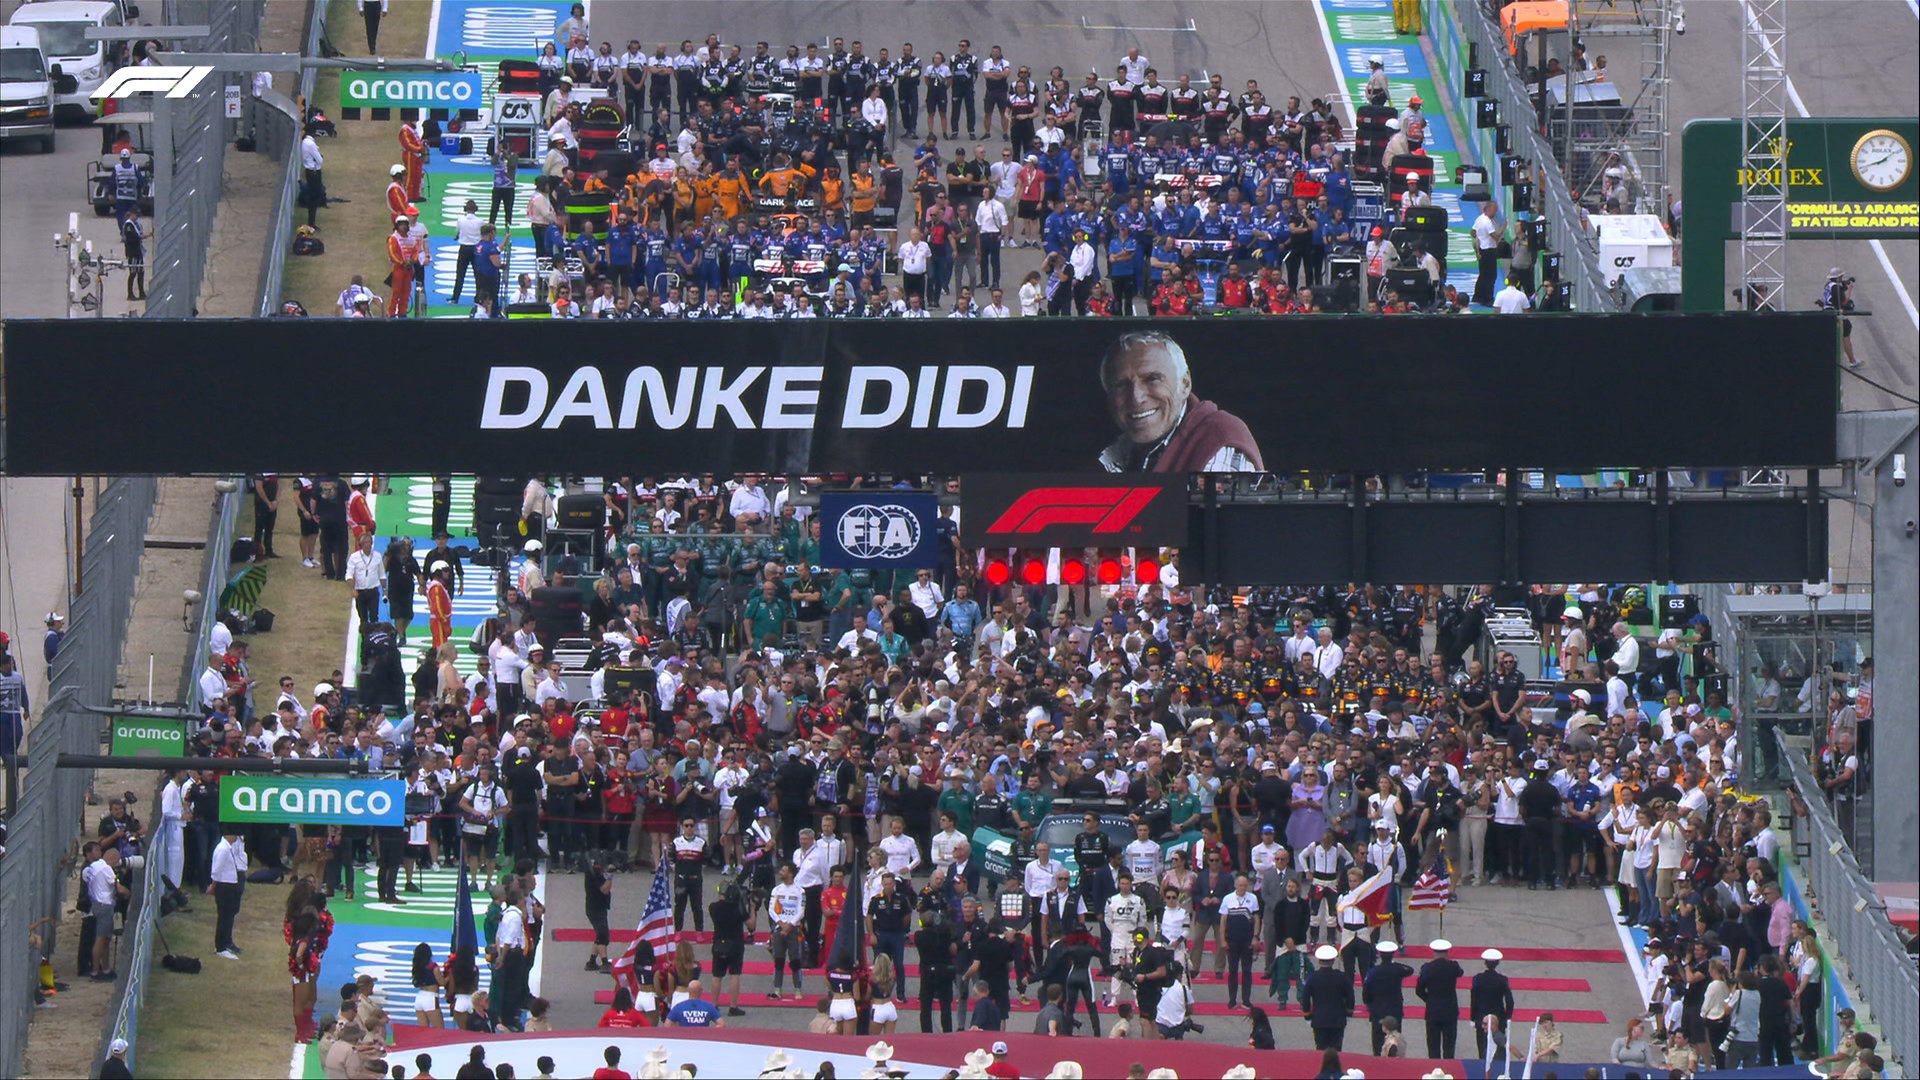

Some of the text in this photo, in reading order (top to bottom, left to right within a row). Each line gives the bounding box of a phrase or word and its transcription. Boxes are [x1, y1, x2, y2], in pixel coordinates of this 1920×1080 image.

[1473, 73, 1481, 81] 22
[349, 79, 472, 101] aramco
[229, 104, 236, 114] F
[1485, 103, 1494, 112] 24
[1737, 168, 1824, 186] ROLEX
[1865, 204, 1919, 215] ARAMC
[1791, 216, 1849, 227] STATES
[1850, 216, 1899, 227] GRAND
[480, 365, 1036, 430] DANKE DIDI
[1669, 599, 1685, 609] 63
[117, 726, 182, 741] aramco
[232, 786, 392, 816] aramco
[1099, 819, 1130, 828] ARTIN
[984, 861, 1011, 876] aram
[683, 1010, 708, 1018] EVENT
